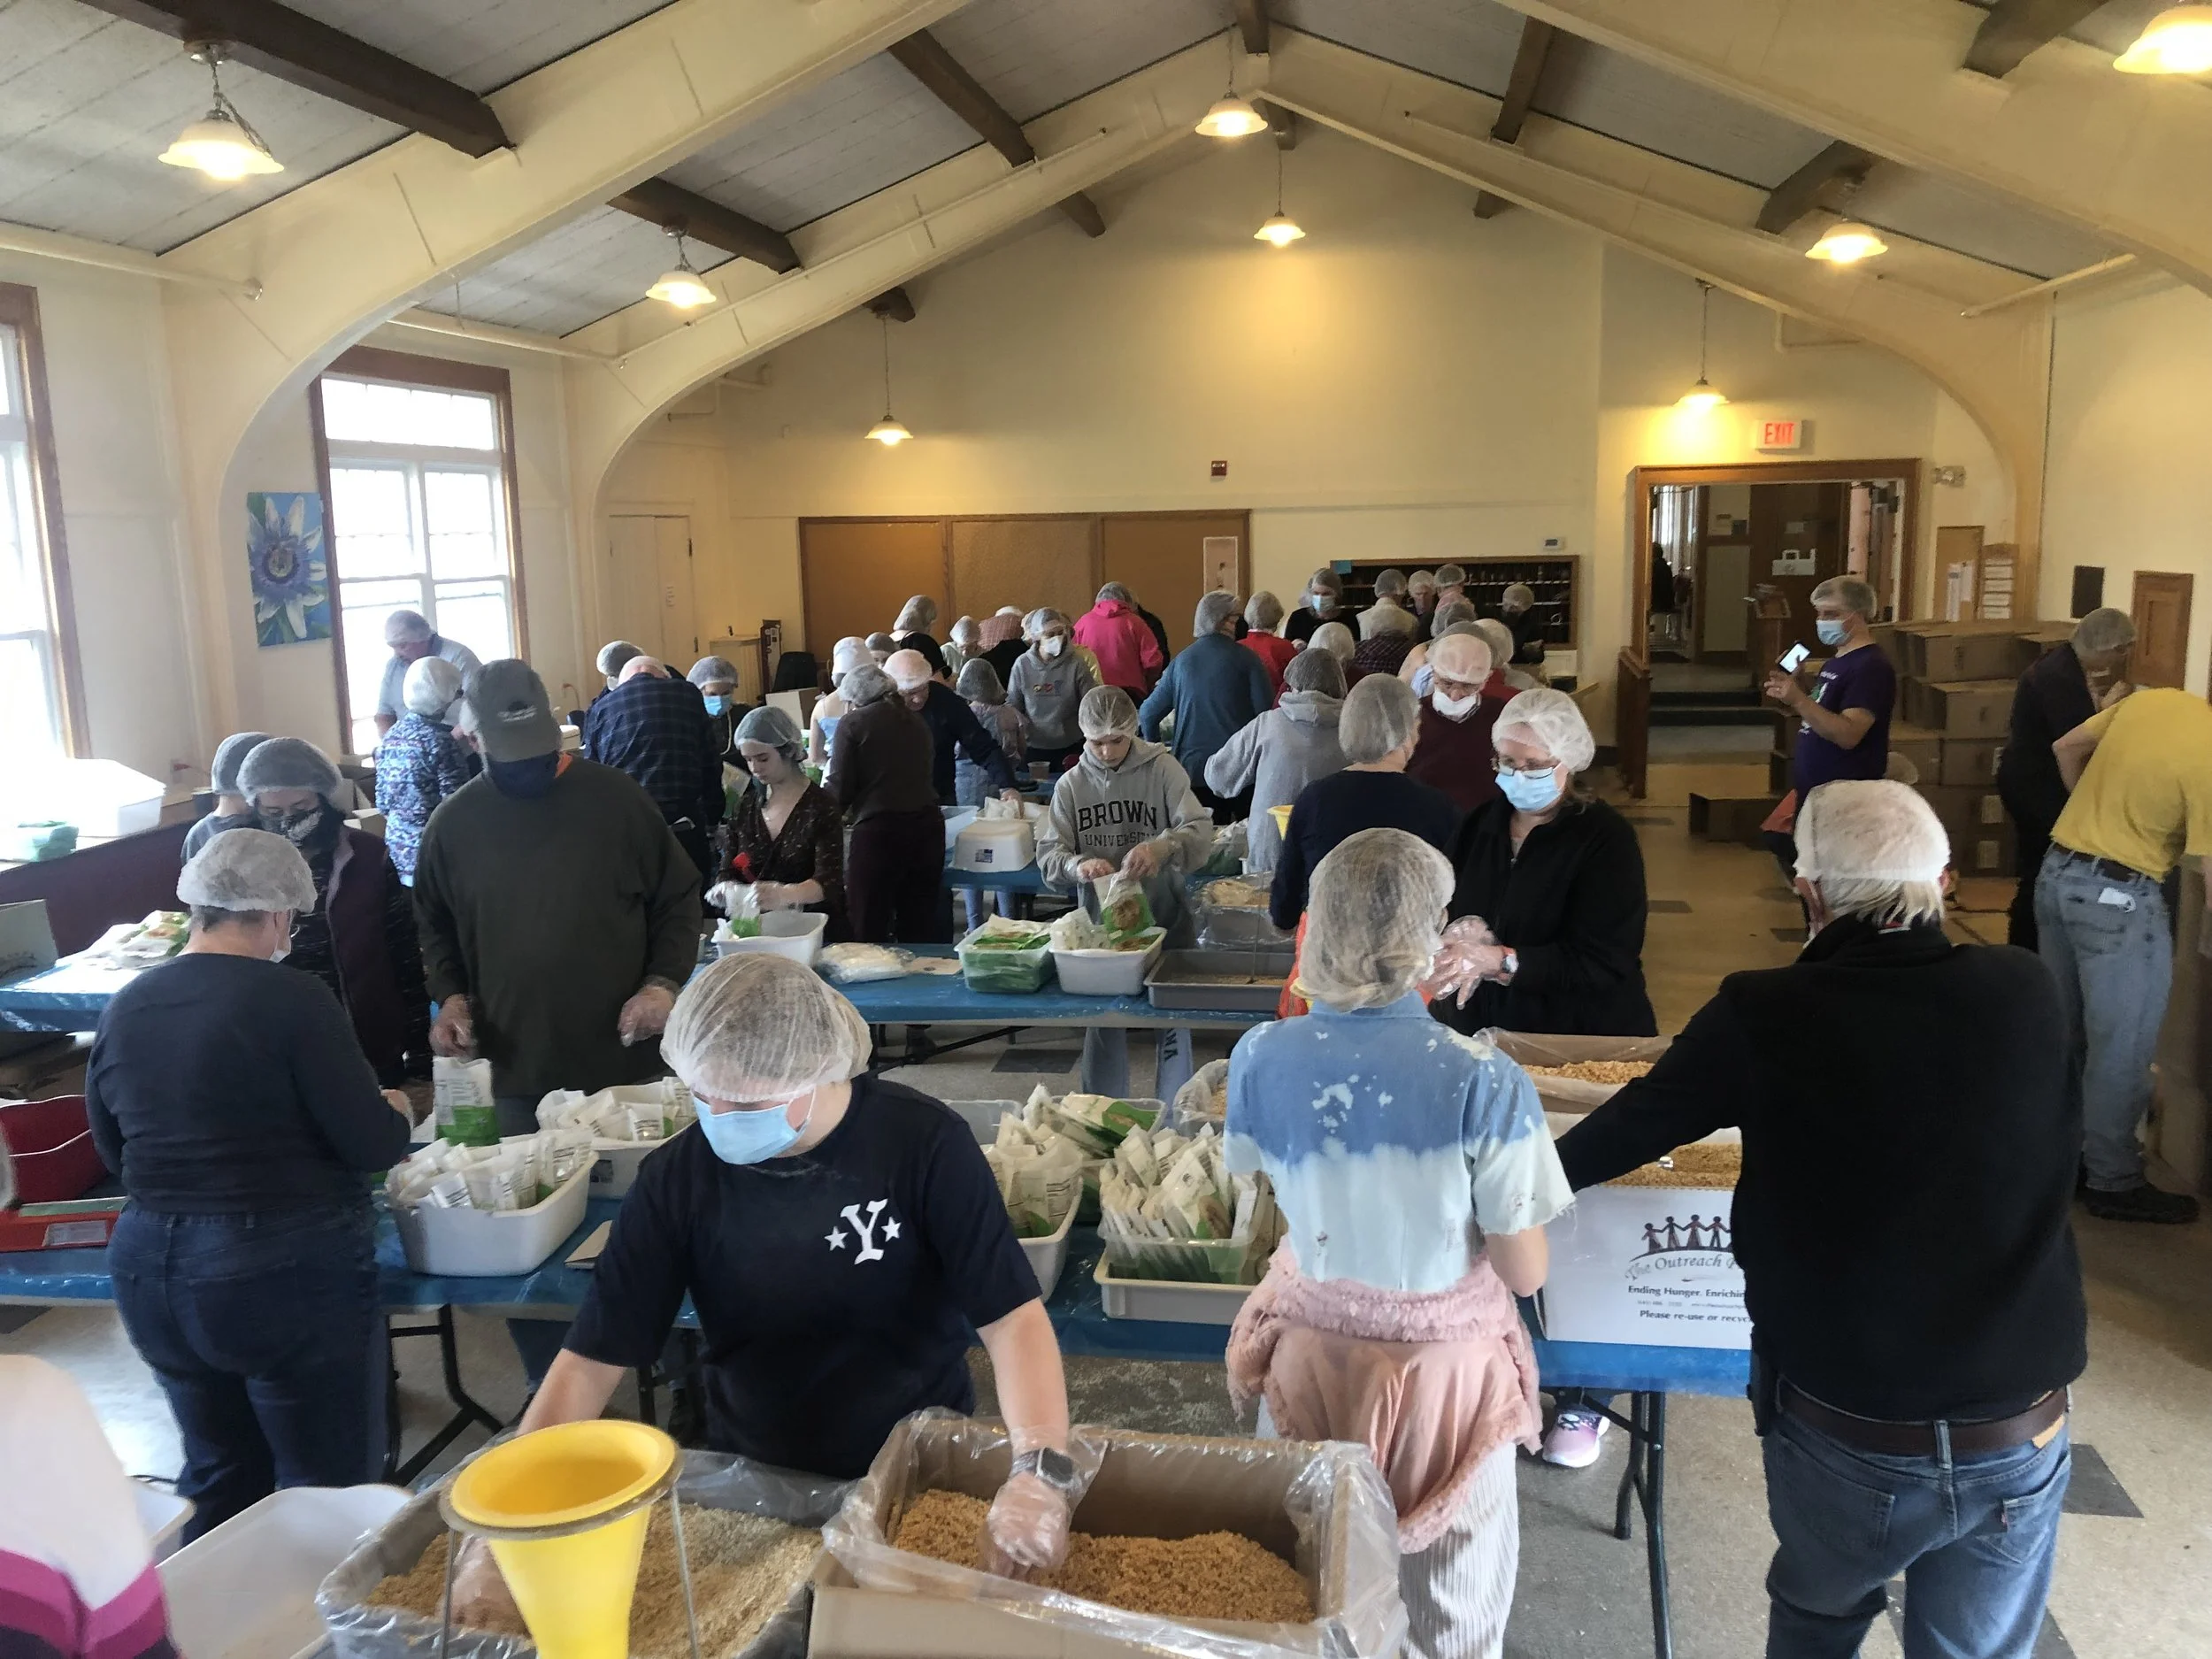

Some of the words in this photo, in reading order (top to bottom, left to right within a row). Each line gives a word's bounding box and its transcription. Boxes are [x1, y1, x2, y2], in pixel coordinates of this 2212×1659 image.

[1764, 423, 1794, 444] EXIT
[1078, 800, 1157, 832] BROWN
[1084, 831, 1155, 847] UNIVERSI
[840, 1198, 888, 1265] Y
[1655, 1254, 1722, 1270] Outreach
[1628, 1286, 1661, 1296] Ending
[1706, 1289, 1745, 1298] Enrichin
[1640, 1310, 1671, 1319] Please
